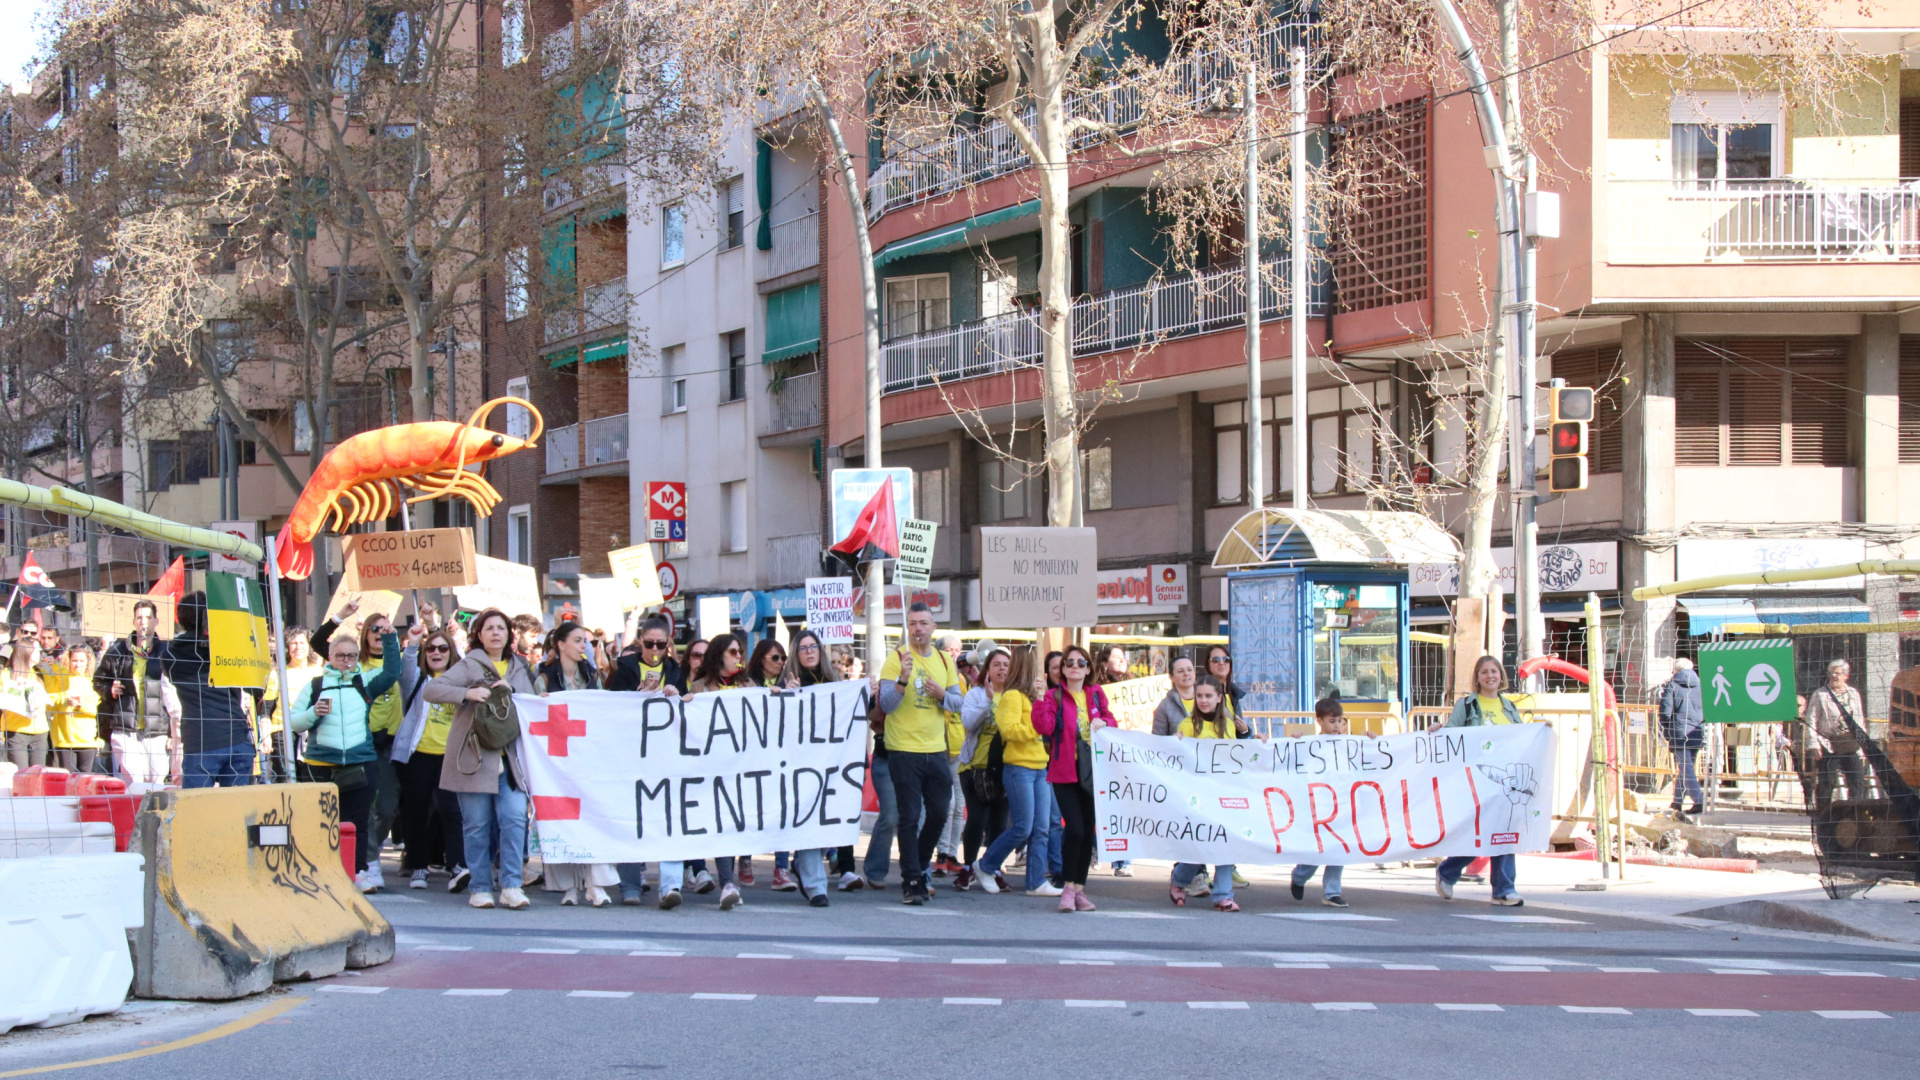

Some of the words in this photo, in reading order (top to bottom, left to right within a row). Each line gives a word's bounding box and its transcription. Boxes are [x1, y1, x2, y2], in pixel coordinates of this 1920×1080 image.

[661, 491, 674, 504] M
[904, 521, 931, 531] BAIXAR
[361, 537, 397, 553] CCOO
[409, 535, 435, 550] UGT
[901, 543, 928, 553] EDUCAR
[988, 536, 1007, 553] LES
[1015, 537, 1048, 553] AULES
[900, 554, 925, 564] MILLOR
[358, 563, 401, 578] VENUTS
[411, 559, 421, 576] 4
[422, 561, 464, 575] GAMBES
[1013, 559, 1029, 575] NO
[1033, 559, 1079, 575] MENTEIXEN
[1588, 559, 1608, 575] Bar
[811, 583, 844, 596] INVERTIR
[988, 586, 995, 602] EL
[1000, 586, 1065, 602] DEPARTAMENT
[1097, 577, 1123, 599] eral
[1126, 576, 1149, 603] Opt
[784, 595, 807, 609] Cafete
[808, 598, 818, 610] EN
[819, 593, 853, 610] EDUCACIÓ
[811, 609, 821, 624] ÉS
[824, 609, 853, 622] INVERTIR
[826, 625, 853, 638] FUTUR
[215, 656, 248, 668] Disculpin
[1111, 678, 1170, 706] +RECURS
[1251, 681, 1276, 694] ONCE
[1194, 741, 1245, 774] LES
[1271, 739, 1393, 775] MESTRES
[1415, 733, 1466, 764] DIEM
[541, 832, 567, 844] scola
